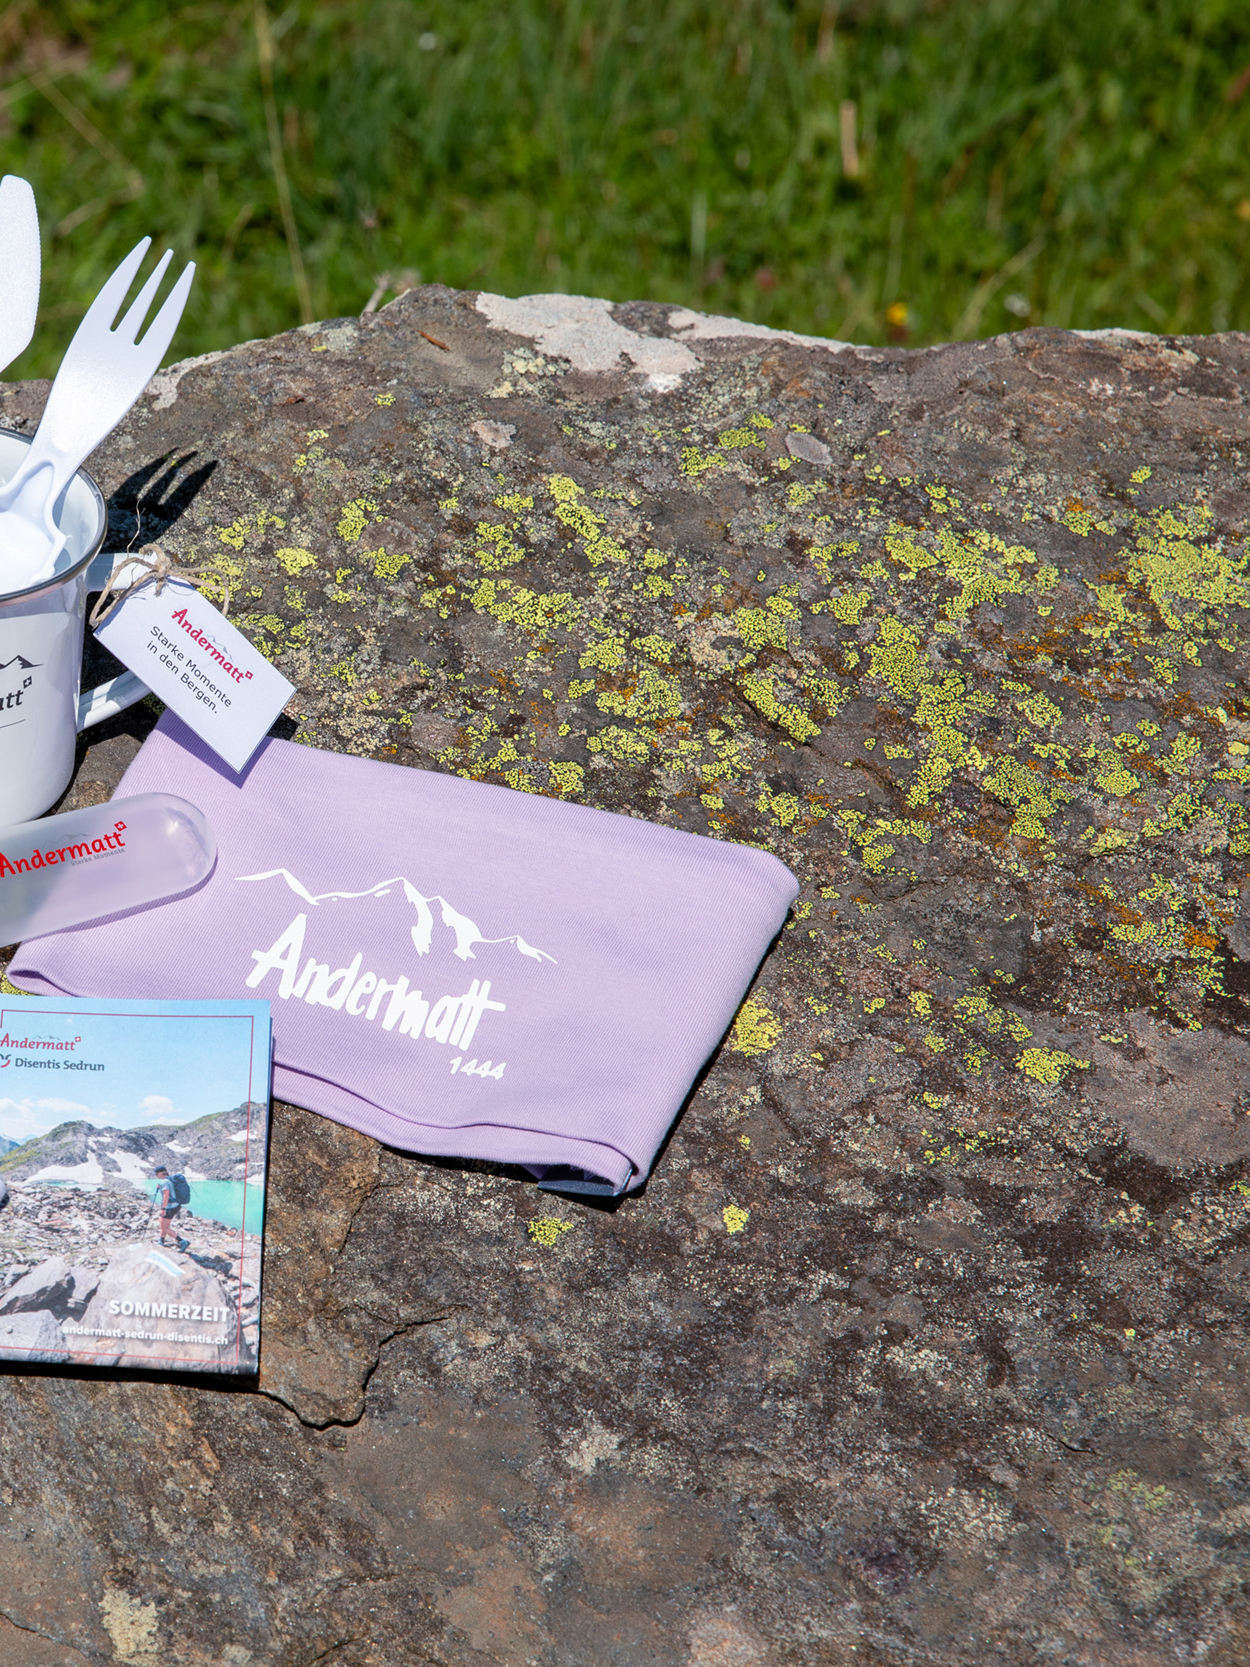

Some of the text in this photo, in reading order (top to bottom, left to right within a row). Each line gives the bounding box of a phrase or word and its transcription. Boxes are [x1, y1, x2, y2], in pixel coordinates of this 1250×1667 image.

[170, 608, 245, 684] Andermatt
[146, 640, 218, 714] in den Bergen.
[150, 625, 232, 708] Starke Momente
[70, 847, 126, 867] Starke Momente
[245, 913, 507, 1051] Andermatt
[0, 1032, 76, 1051] Andermatt
[15, 1057, 105, 1072] Disentis Sedrun
[450, 1056, 507, 1080] 1444
[108, 1300, 230, 1323] SOMMERZEIT
[61, 1324, 229, 1346] andermatt-sedrun-disentis.ch
